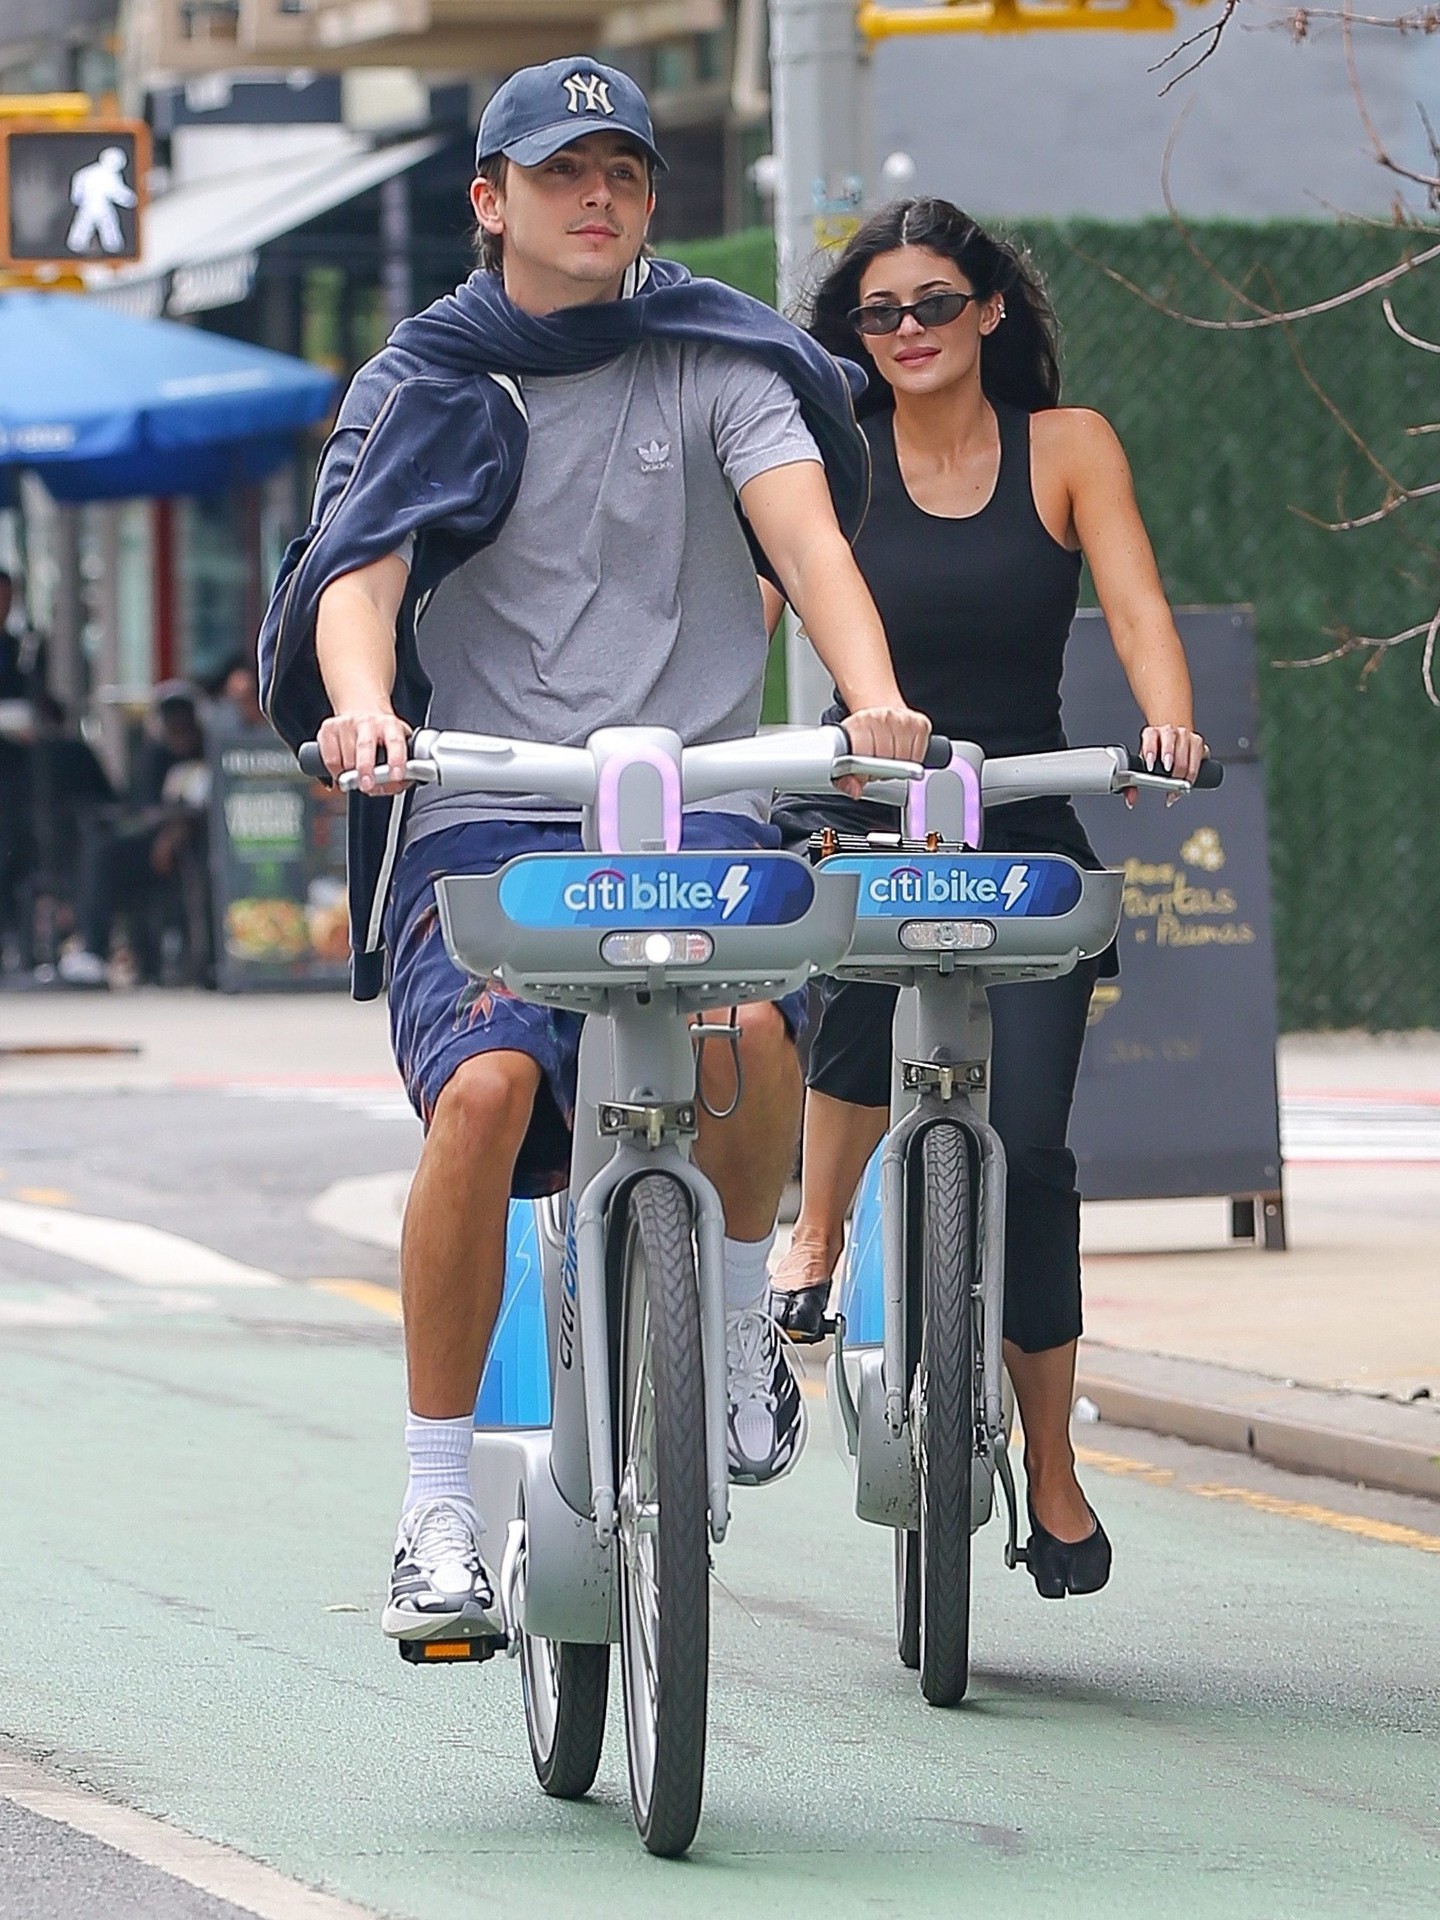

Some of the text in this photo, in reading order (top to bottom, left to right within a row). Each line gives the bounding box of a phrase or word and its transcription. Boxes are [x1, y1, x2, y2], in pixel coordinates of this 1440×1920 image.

[563, 73, 615, 114] NY
[564, 868, 714, 911] citi bike
[869, 866, 998, 902] citi bike
